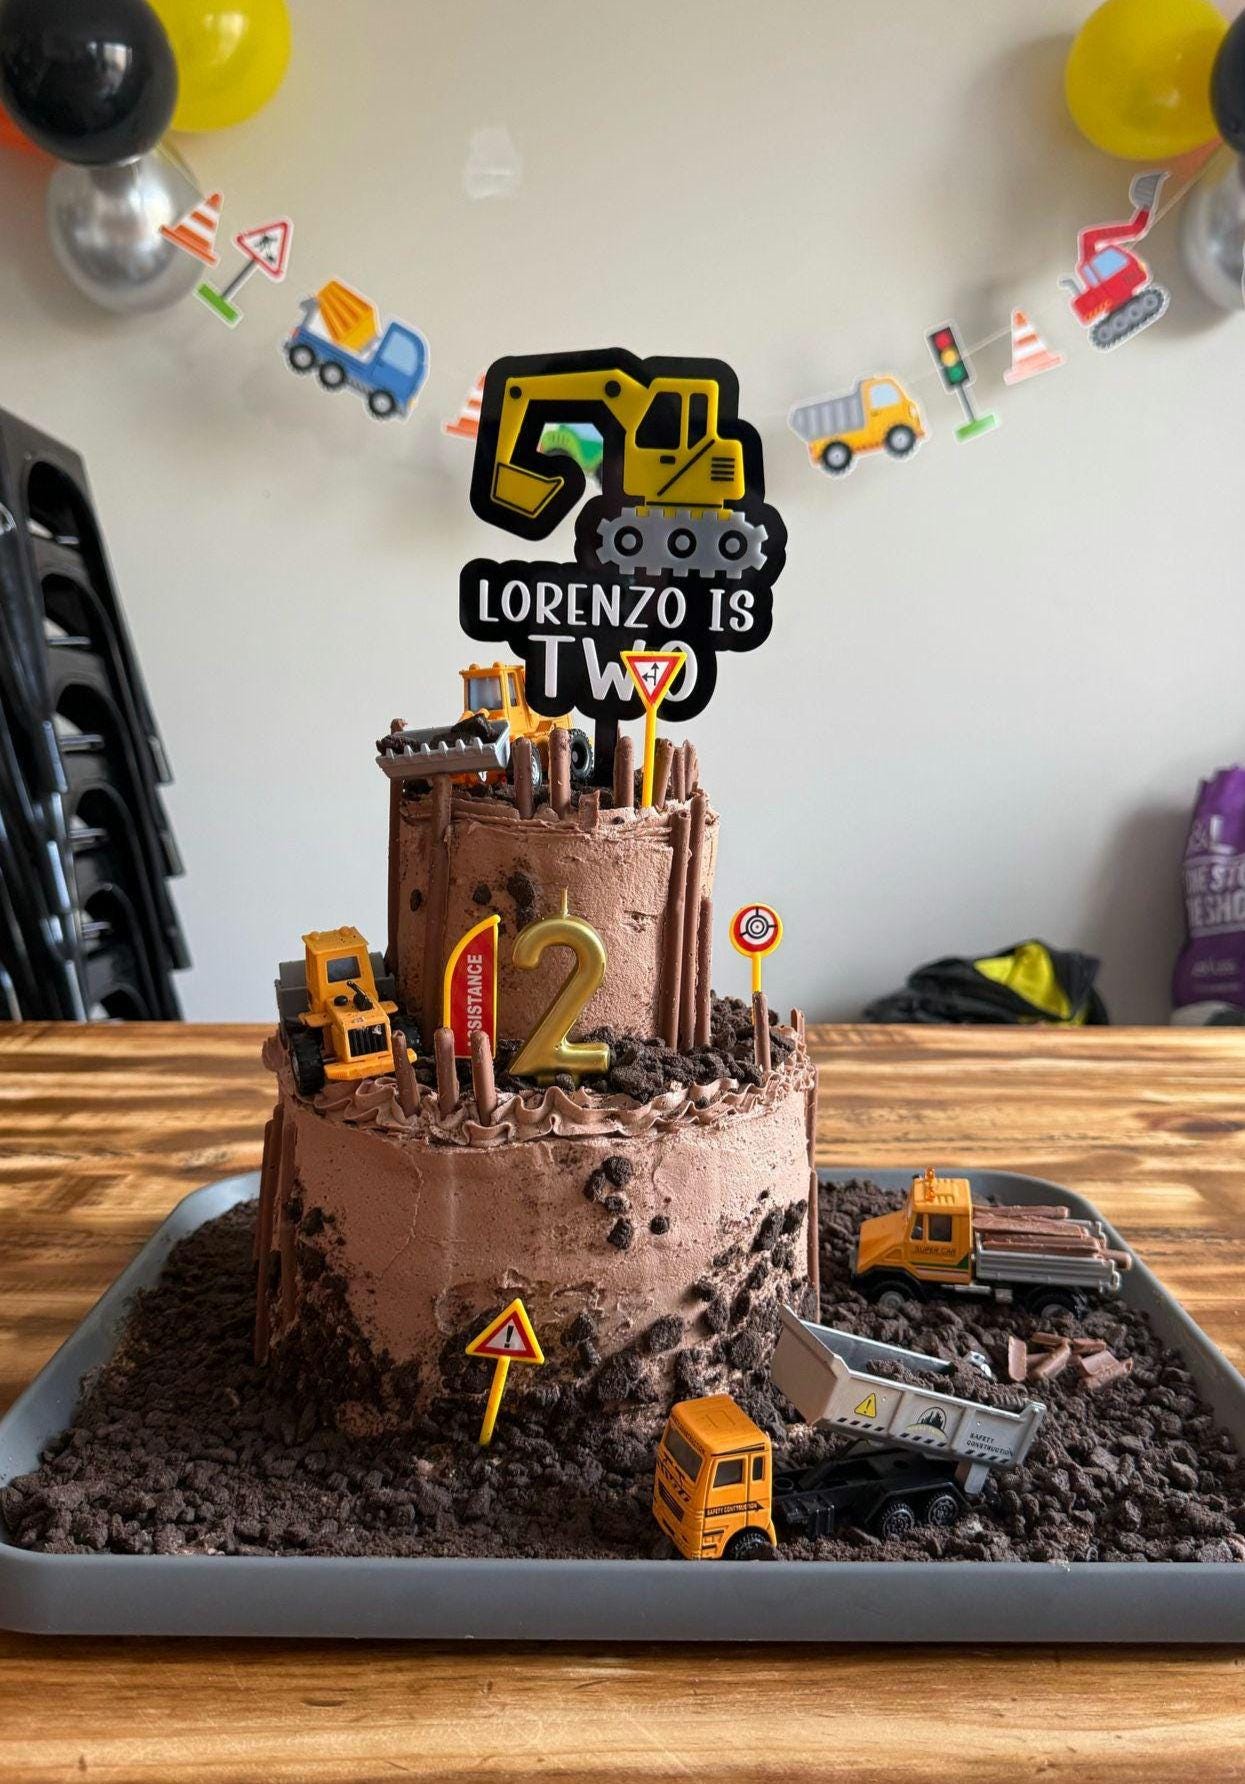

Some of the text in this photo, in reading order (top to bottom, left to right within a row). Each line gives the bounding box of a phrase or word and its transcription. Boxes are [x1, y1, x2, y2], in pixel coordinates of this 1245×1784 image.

[479, 578, 755, 632] LORENZO IS
[528, 634, 698, 702] TWO
[467, 954, 483, 1047] SISTANCE
[509, 915, 609, 1076] 2
[966, 1440, 1014, 1456] CONSTRUCTION
[970, 1432, 994, 1444] SAFETY
[707, 1506, 724, 1516] SAFETY
